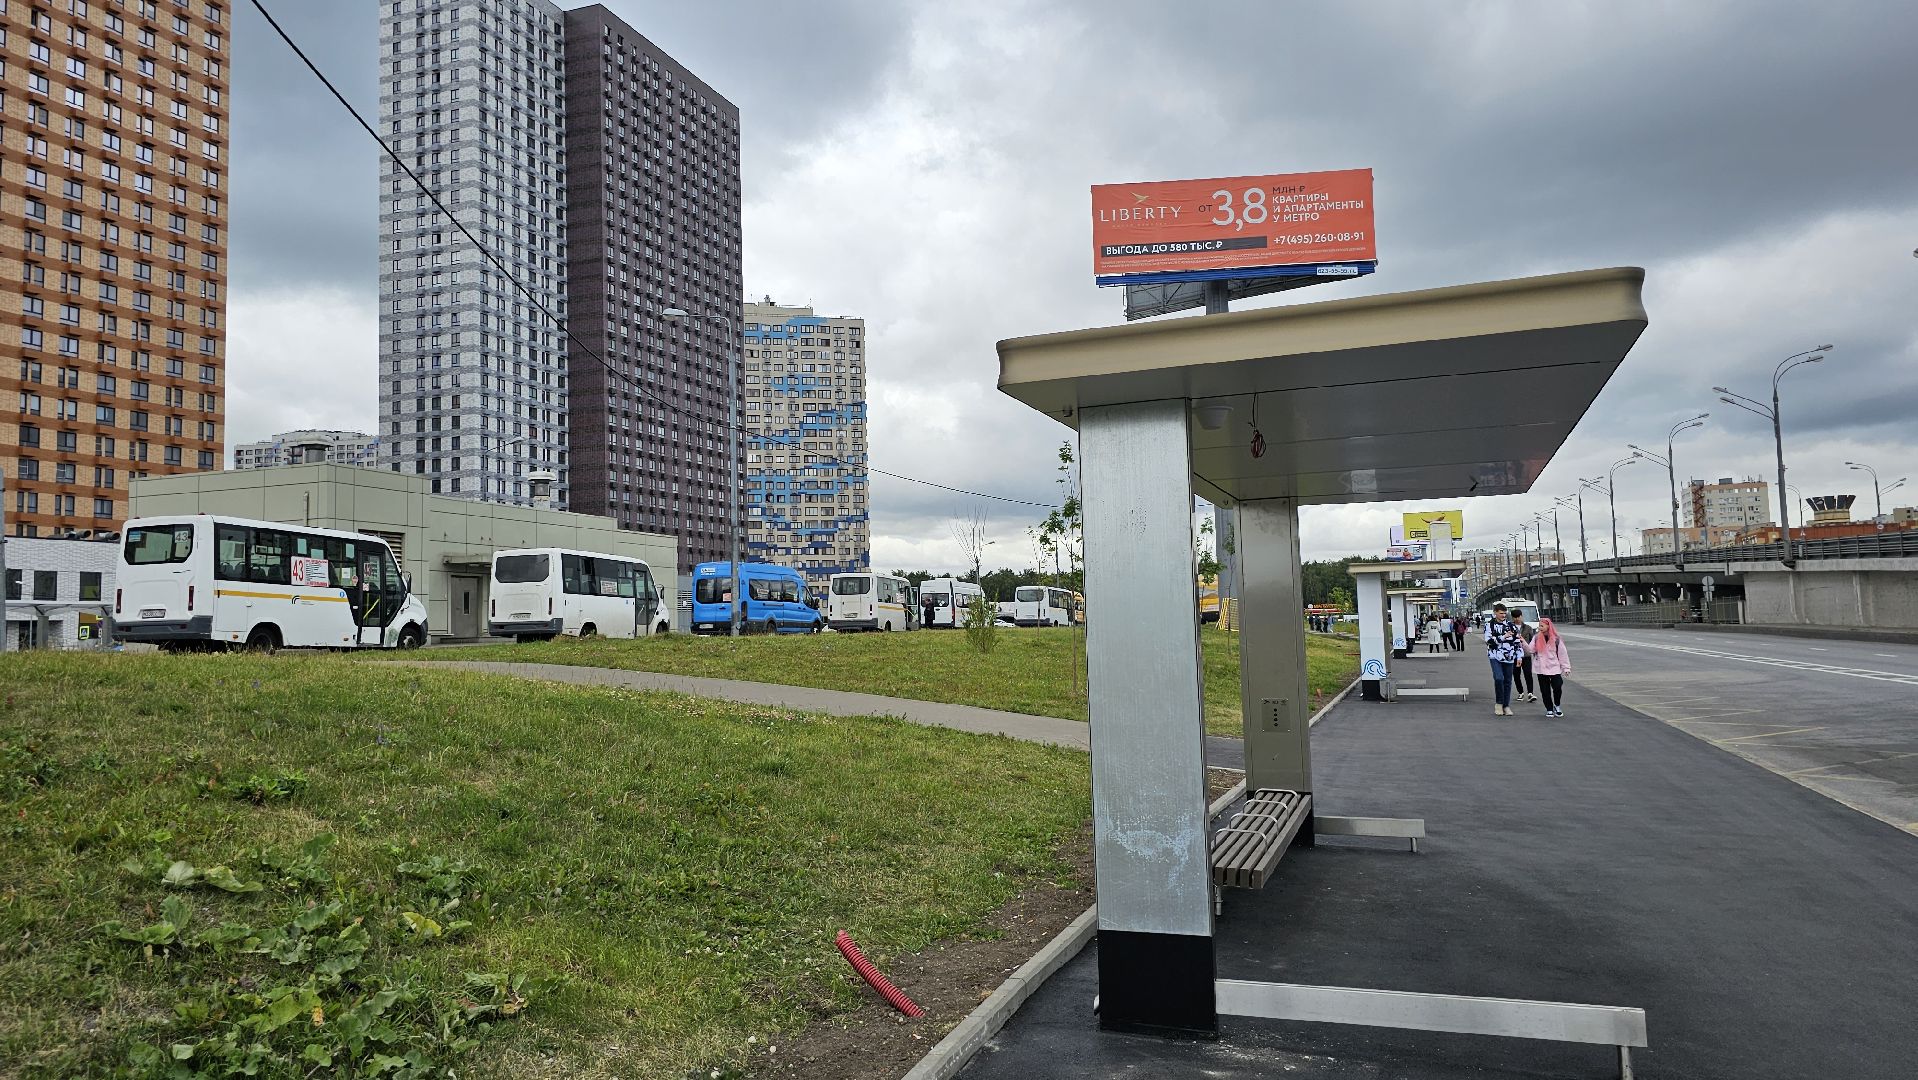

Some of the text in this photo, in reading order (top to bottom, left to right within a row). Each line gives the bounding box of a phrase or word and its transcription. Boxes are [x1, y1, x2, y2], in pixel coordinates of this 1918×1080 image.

[1272, 186, 1296, 194] МЛН
[1272, 193, 1329, 204] КВАРТИРЫ
[1198, 187, 1268, 231] ОТ 3,8
[1273, 200, 1364, 213] И АПАРТАМЕНТЫ
[1100, 206, 1181, 221] LIBERTY
[1273, 212, 1320, 223] У МЕТРО
[1106, 245, 1149, 255] ВЫГОДА
[1152, 244, 1168, 254] ДО
[1170, 243, 1188, 252] 580
[175, 531, 188, 542] 43
[293, 560, 304, 582] 43
